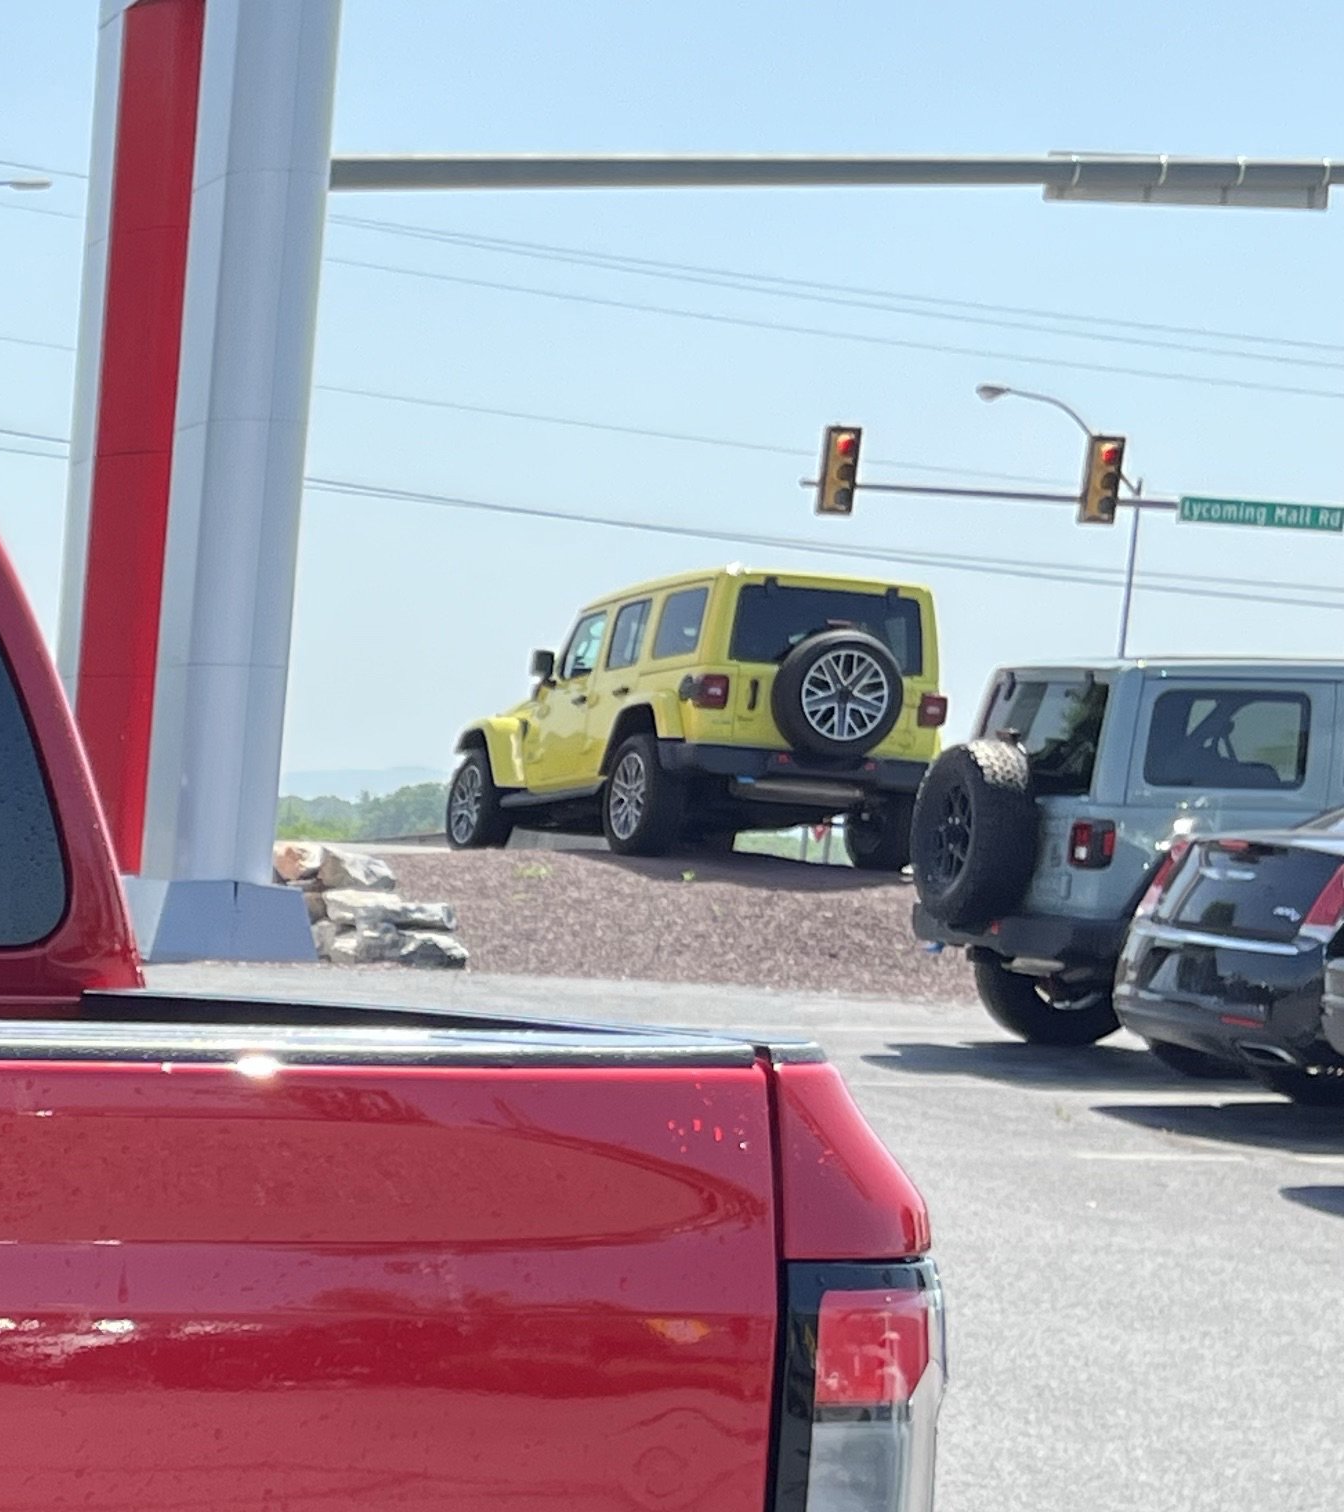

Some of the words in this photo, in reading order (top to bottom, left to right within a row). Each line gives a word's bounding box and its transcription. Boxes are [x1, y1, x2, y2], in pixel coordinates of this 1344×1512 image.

[1183, 500, 1267, 525] Lycoming
[1274, 505, 1311, 525] Mall
[1318, 508, 1341, 527] Rd
